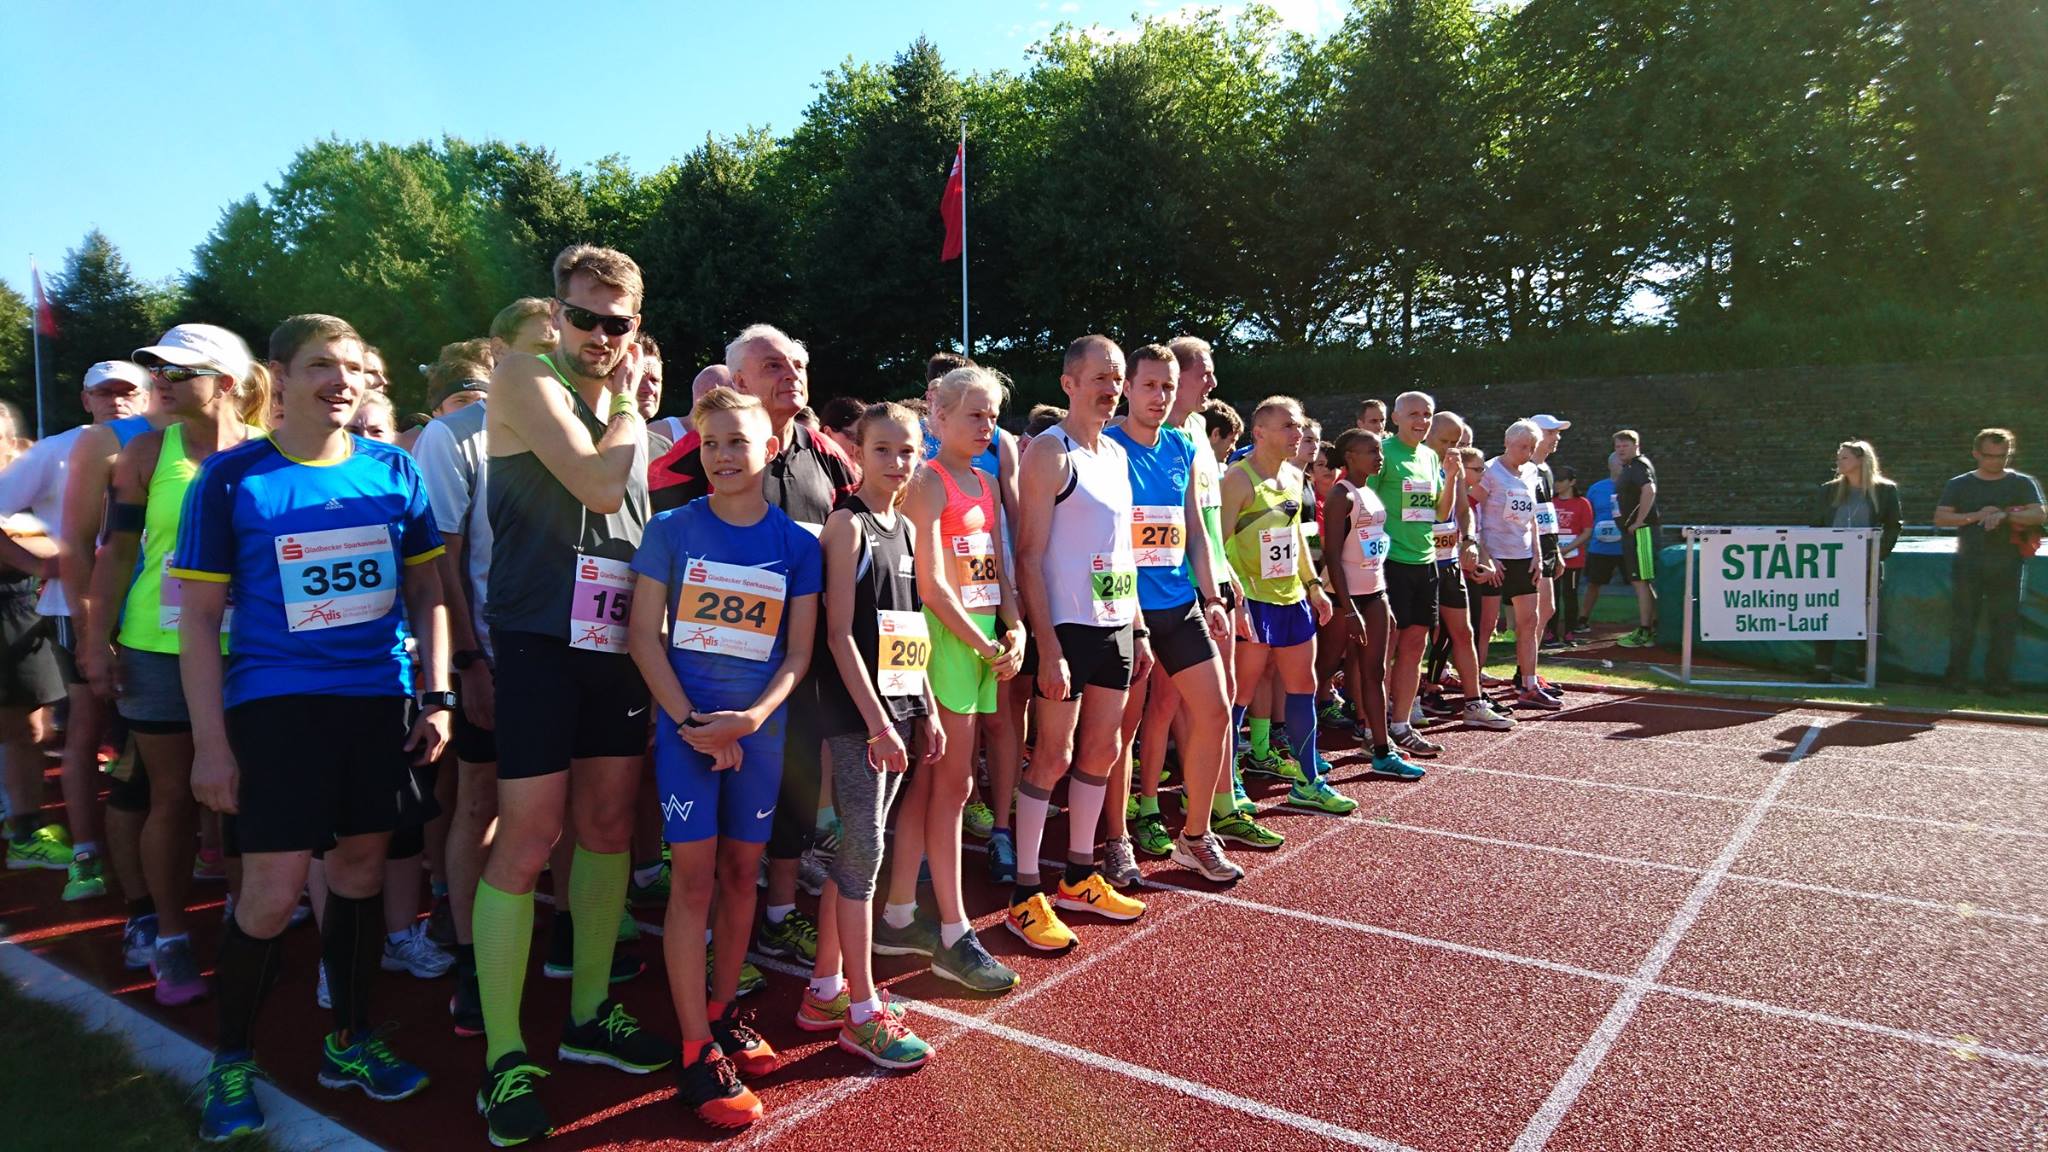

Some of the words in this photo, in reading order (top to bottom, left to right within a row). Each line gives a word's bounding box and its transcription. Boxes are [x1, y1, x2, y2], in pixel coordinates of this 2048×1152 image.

[1410, 494, 1434, 508] 225
[1511, 499, 1533, 512] 334
[1142, 526, 1180, 545] 278
[970, 558, 999, 581] 28
[1721, 542, 1843, 581] START
[302, 559, 382, 596] 358
[1101, 574, 1132, 597] 249
[694, 592, 766, 628] 284
[1724, 589, 1798, 611] Walking
[1805, 589, 1839, 608] und
[1735, 613, 1829, 633] 5km-Lauf
[890, 640, 926, 666] 290
